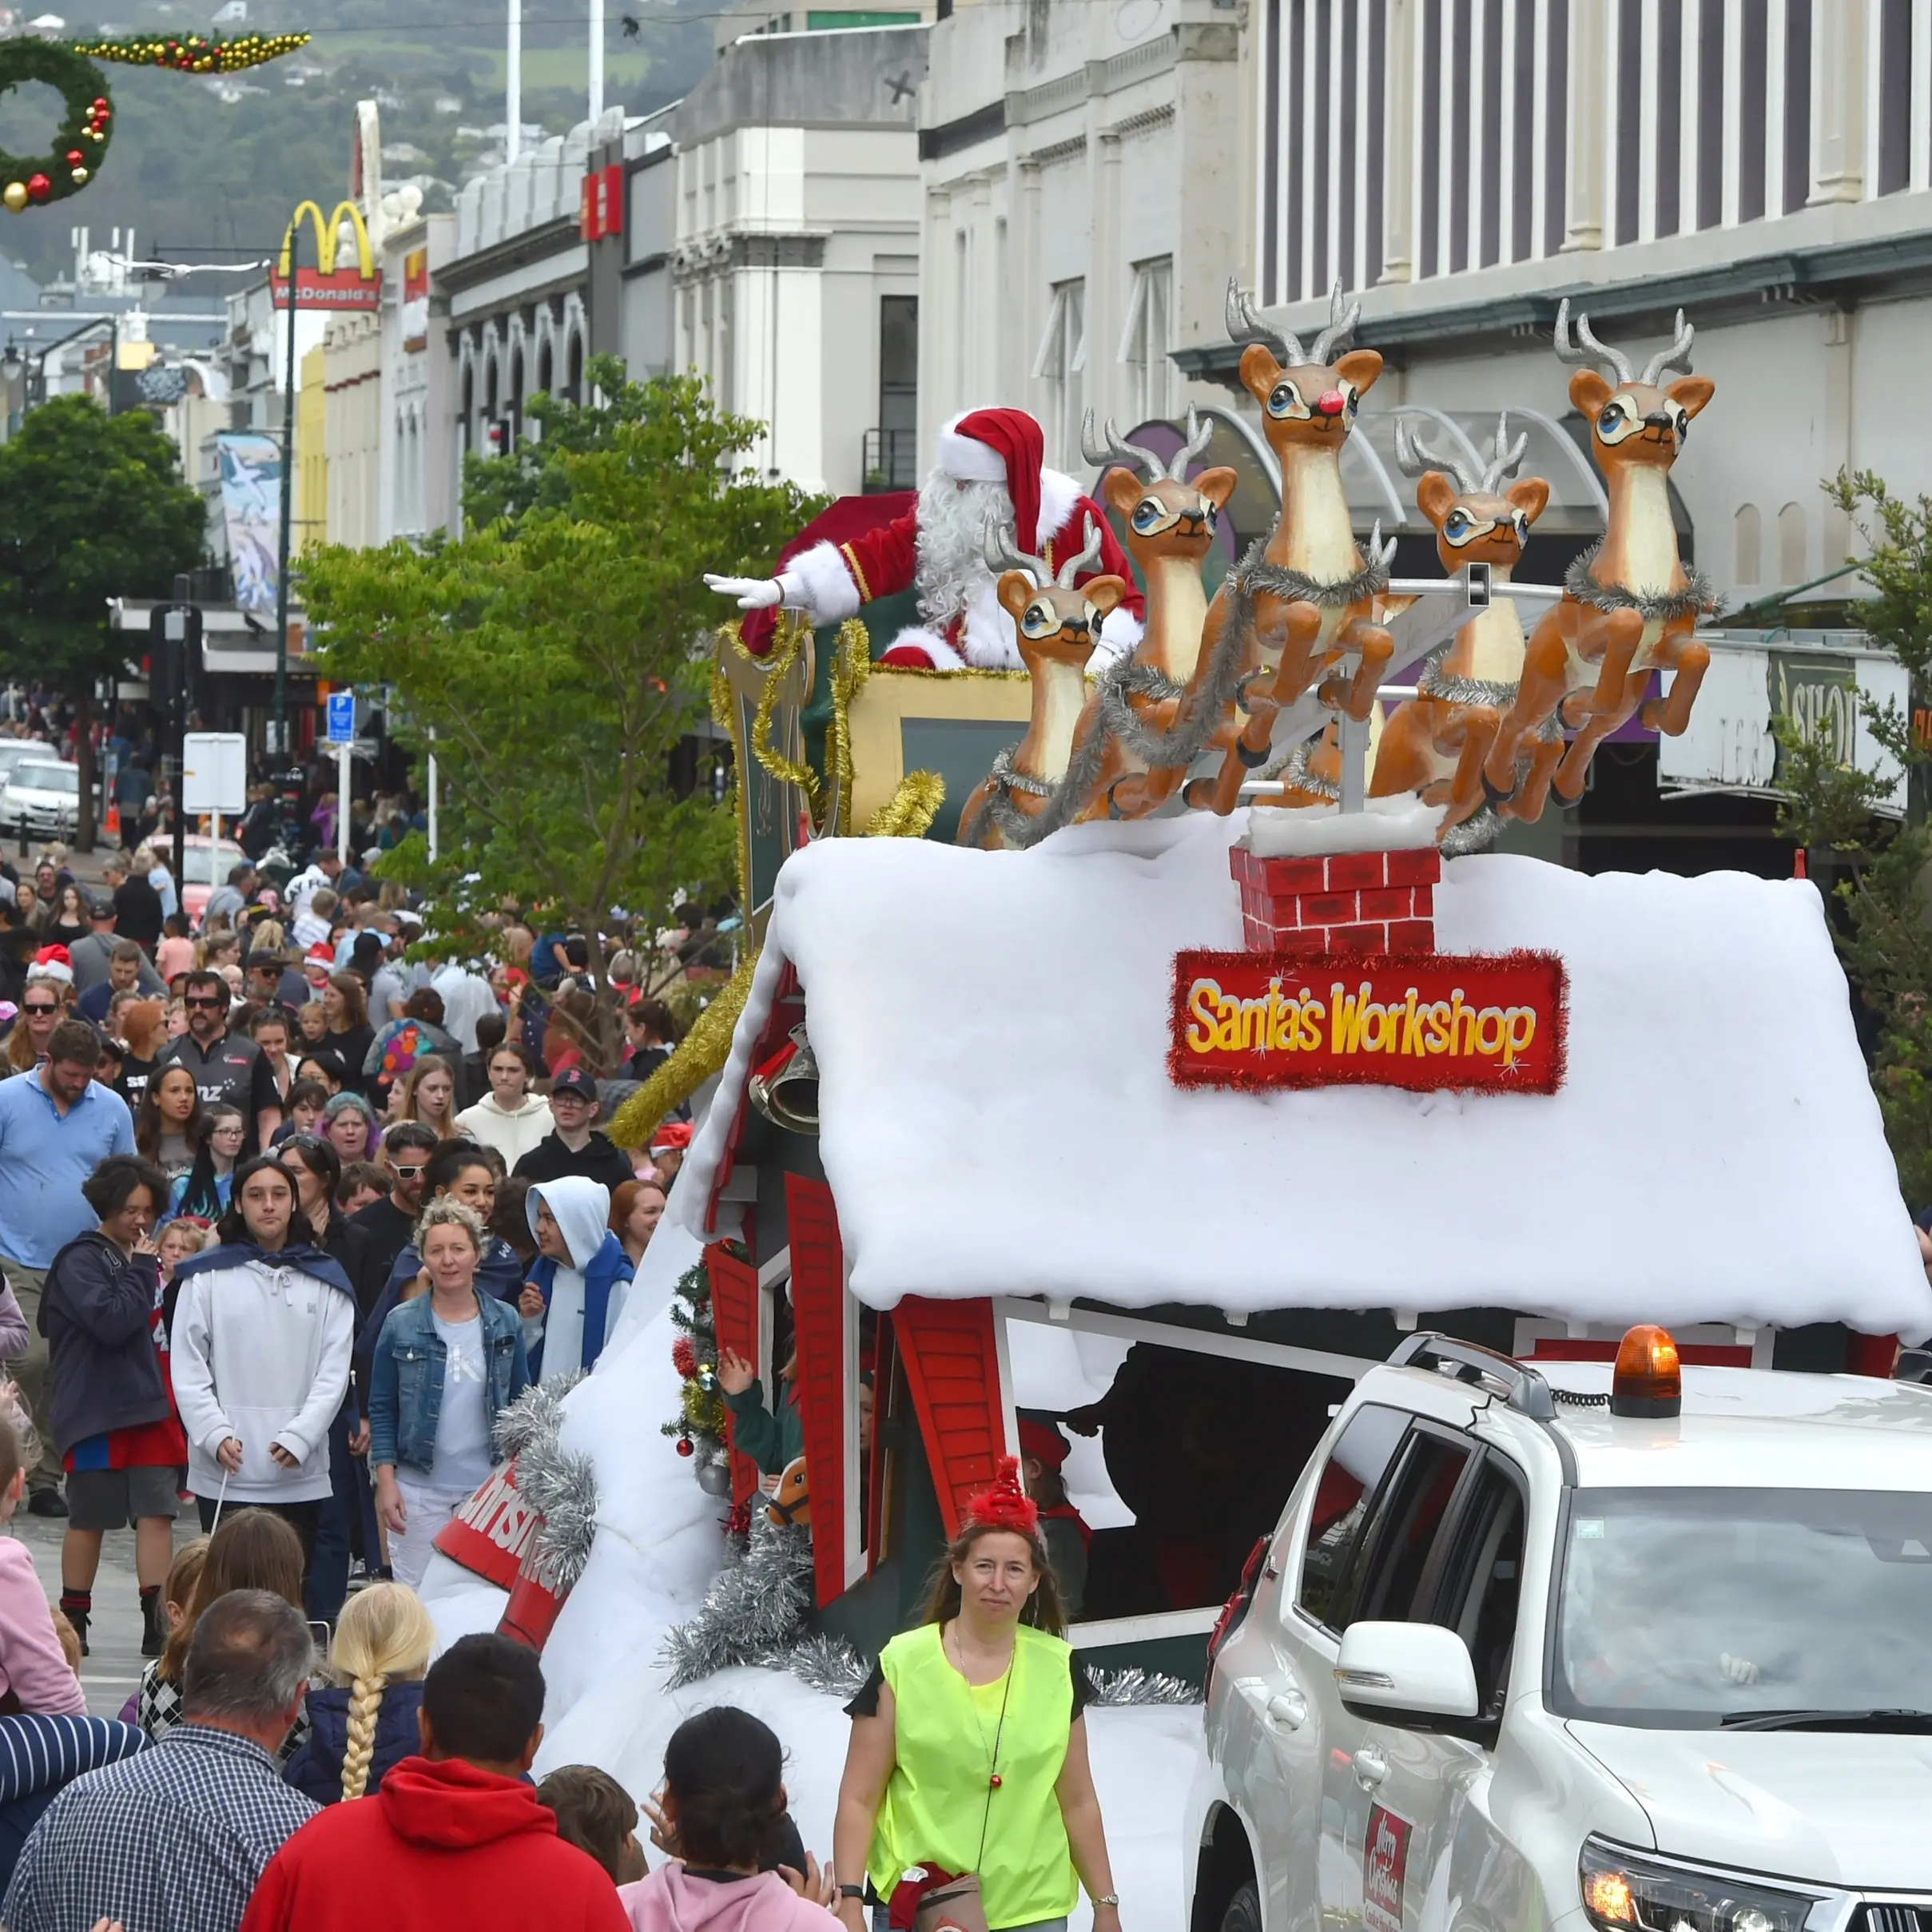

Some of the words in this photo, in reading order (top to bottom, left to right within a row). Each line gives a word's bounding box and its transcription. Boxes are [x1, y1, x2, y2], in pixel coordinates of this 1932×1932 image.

[1791, 682, 1855, 773] SHO
[1187, 977, 1325, 1053] Santa's
[1330, 981, 1536, 1066] Workshop
[1377, 1811, 1397, 1870] Merry
